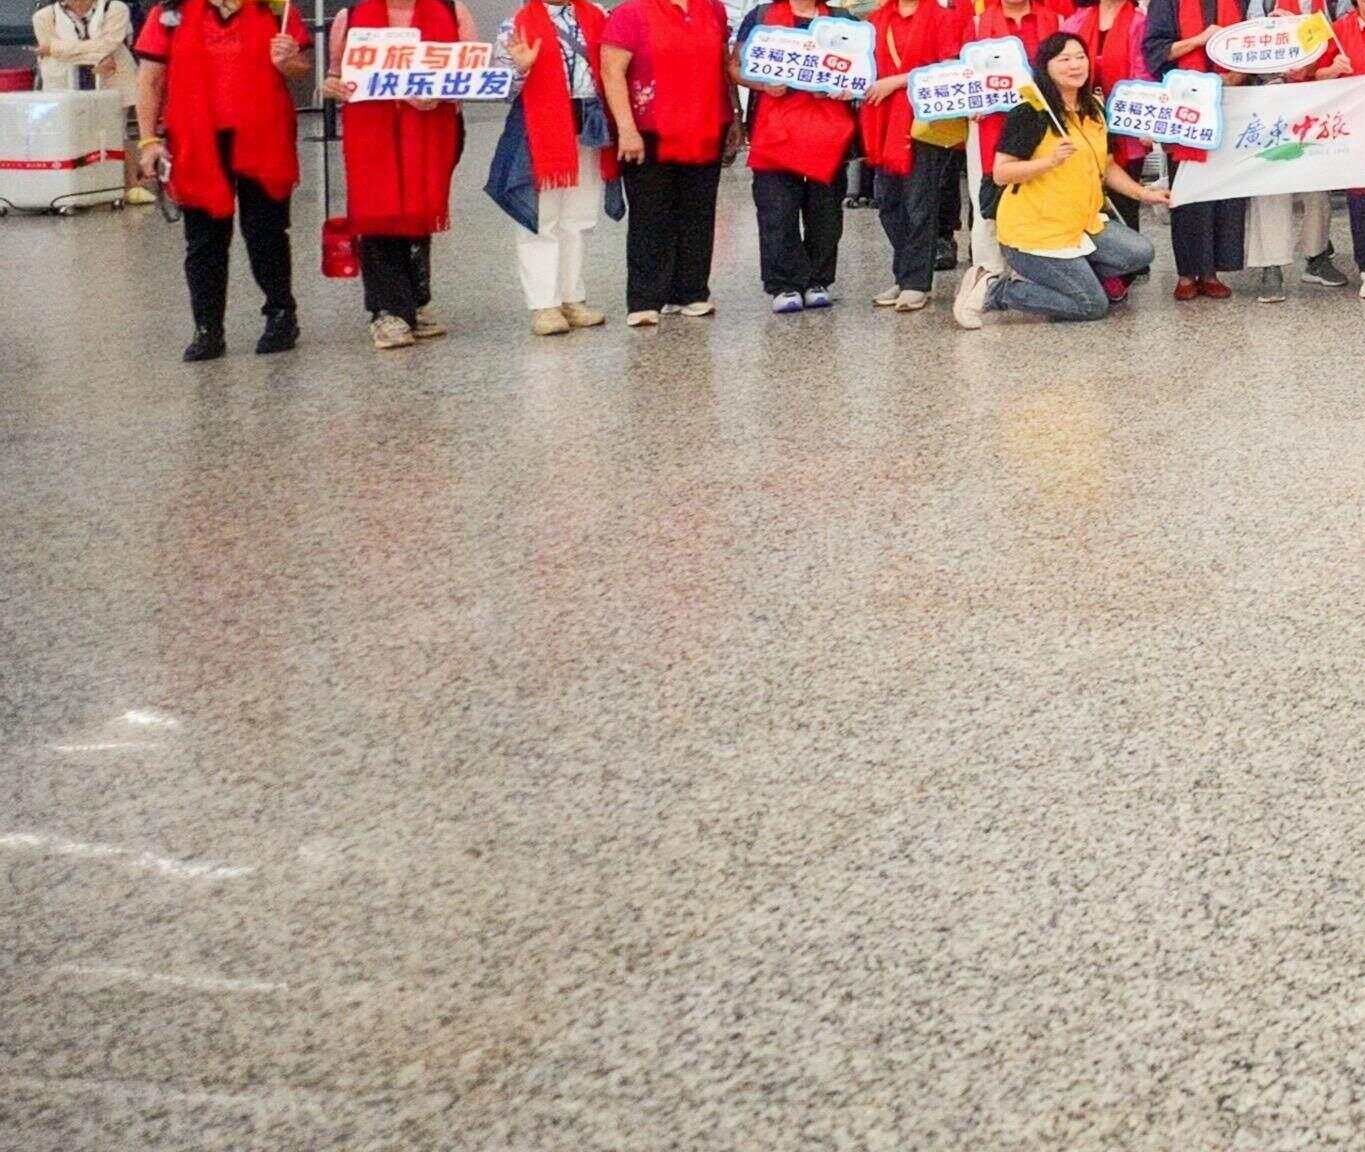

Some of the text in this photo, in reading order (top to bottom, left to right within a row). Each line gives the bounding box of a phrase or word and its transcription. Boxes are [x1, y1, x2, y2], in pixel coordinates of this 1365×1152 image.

[1225, 32, 1289, 49] 广东中旅
[346, 45, 489, 70] 中旅与你
[750, 46, 820, 68] 幸福文旅
[367, 70, 509, 96] 快乐出发
[750, 63, 867, 90] 2025圆梦北极
[918, 81, 983, 99] 幸福文旅
[1114, 100, 1173, 119] 幸福文旅
[1113, 116, 1214, 141] 2025圆梦北极
